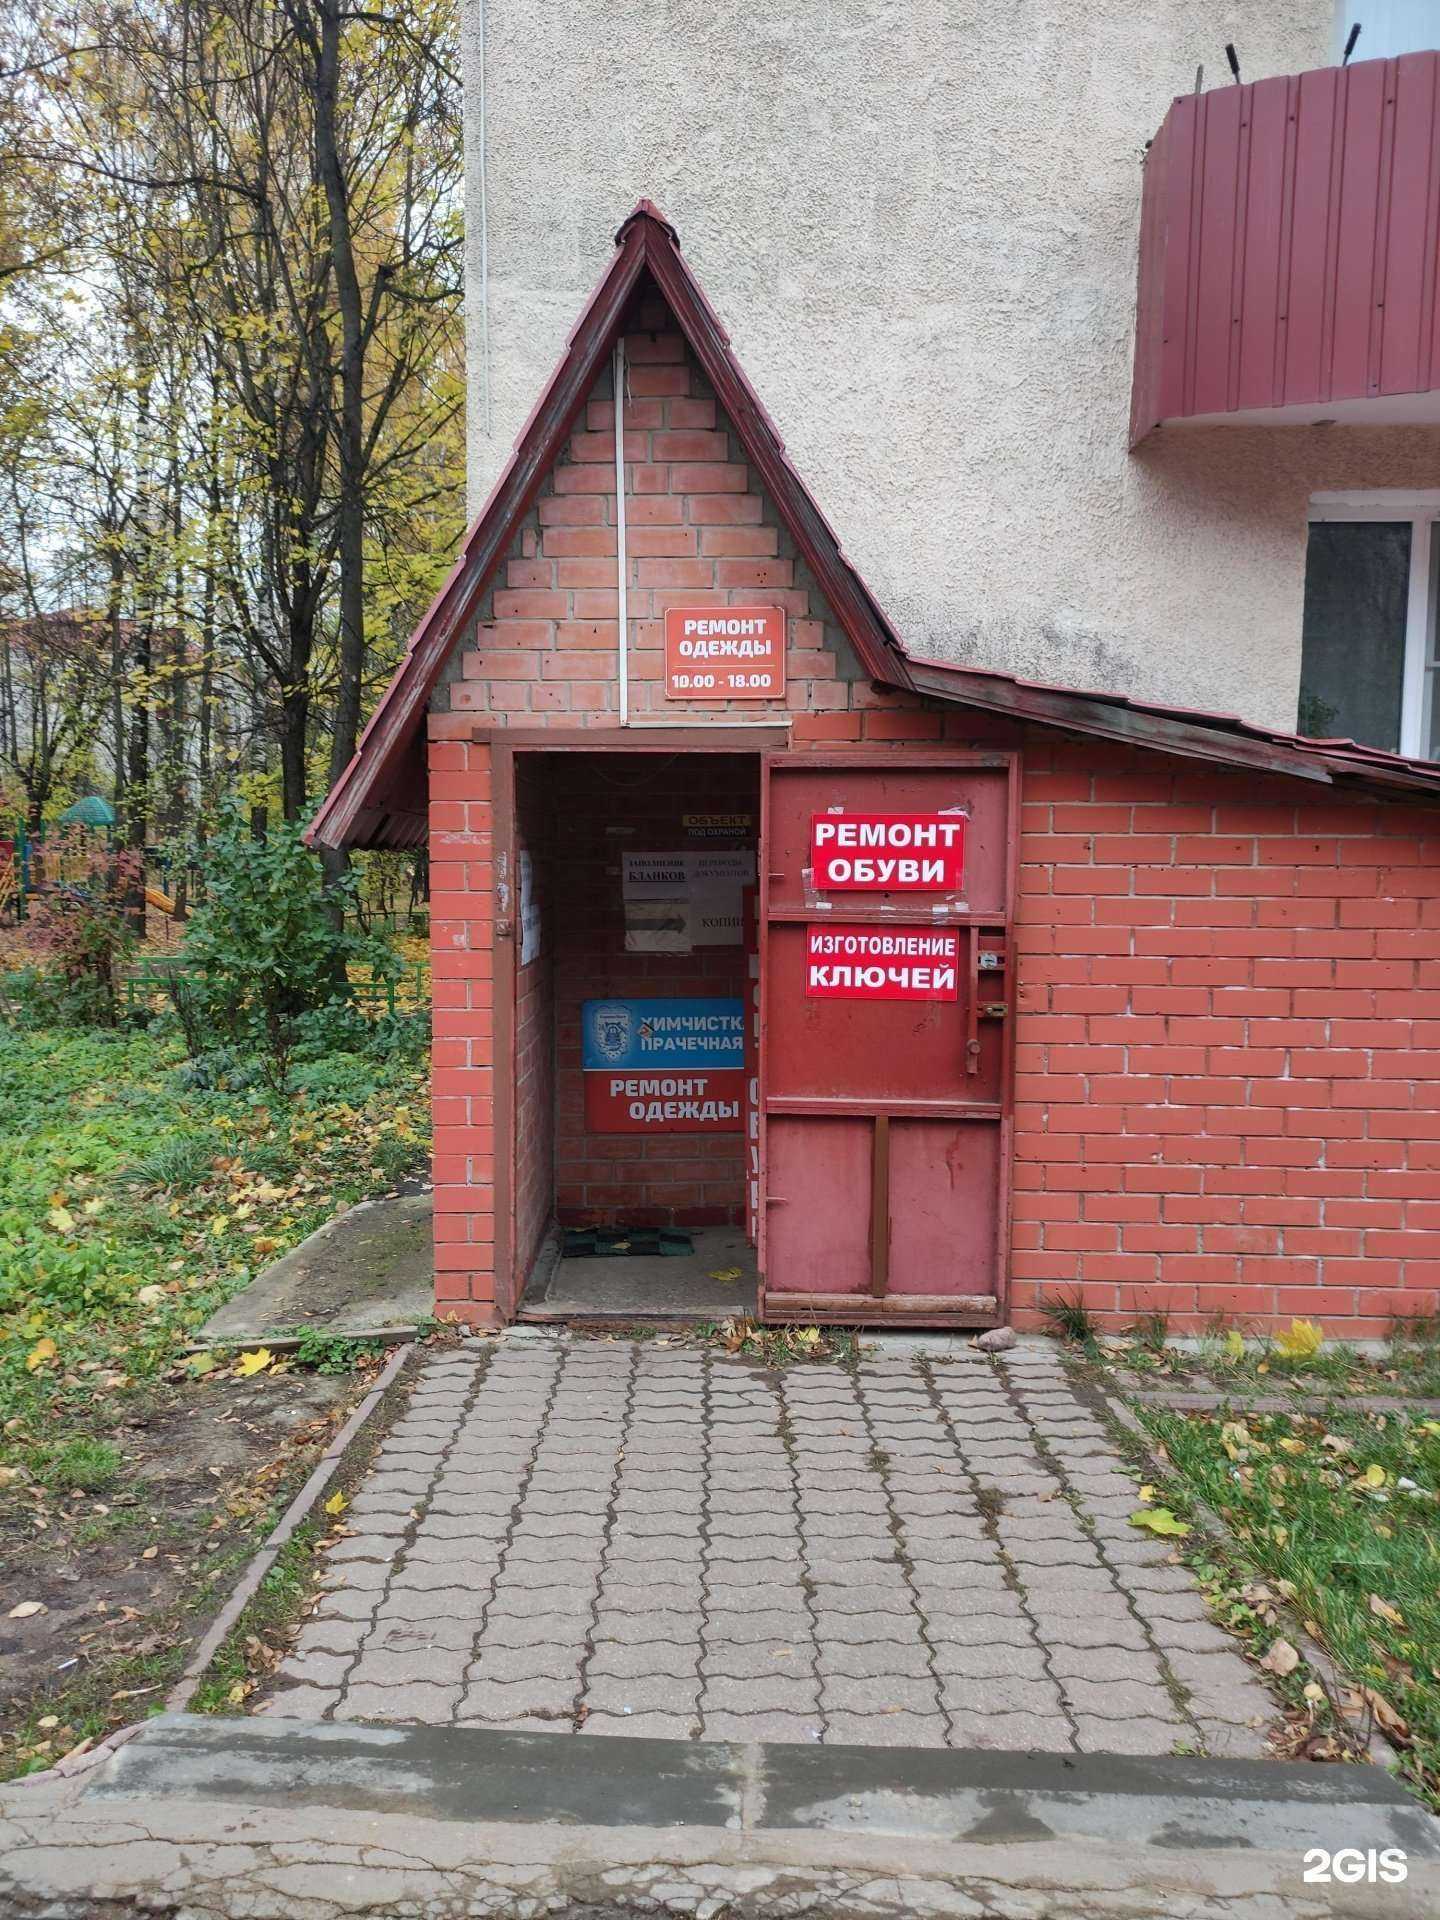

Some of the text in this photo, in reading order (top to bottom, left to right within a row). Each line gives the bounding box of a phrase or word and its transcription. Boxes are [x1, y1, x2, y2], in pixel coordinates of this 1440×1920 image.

[684, 619, 767, 635] РЕМОНТ
[679, 639, 772, 658] ОДЕЖДЫ
[671, 674, 715, 688] 10.00
[727, 674, 771, 688] 18.00
[688, 815, 746, 825] ОБЪЕКТ
[815, 823, 960, 847] РЕМОНТ
[628, 871, 687, 882] БЛАНКОВ
[827, 858, 945, 883] ОБУВИ
[810, 935, 956, 956] ИЗГОТОВЛЕНИЕ
[809, 963, 956, 989] КЛЮЧЕЙ
[641, 1016, 745, 1031] ХИМЧИСТК
[641, 1036, 744, 1051] ПРАЧЕЧНАЯ
[610, 1078, 708, 1097] РЕМОНТ
[629, 1101, 739, 1122] ОДЕЖДЫ
